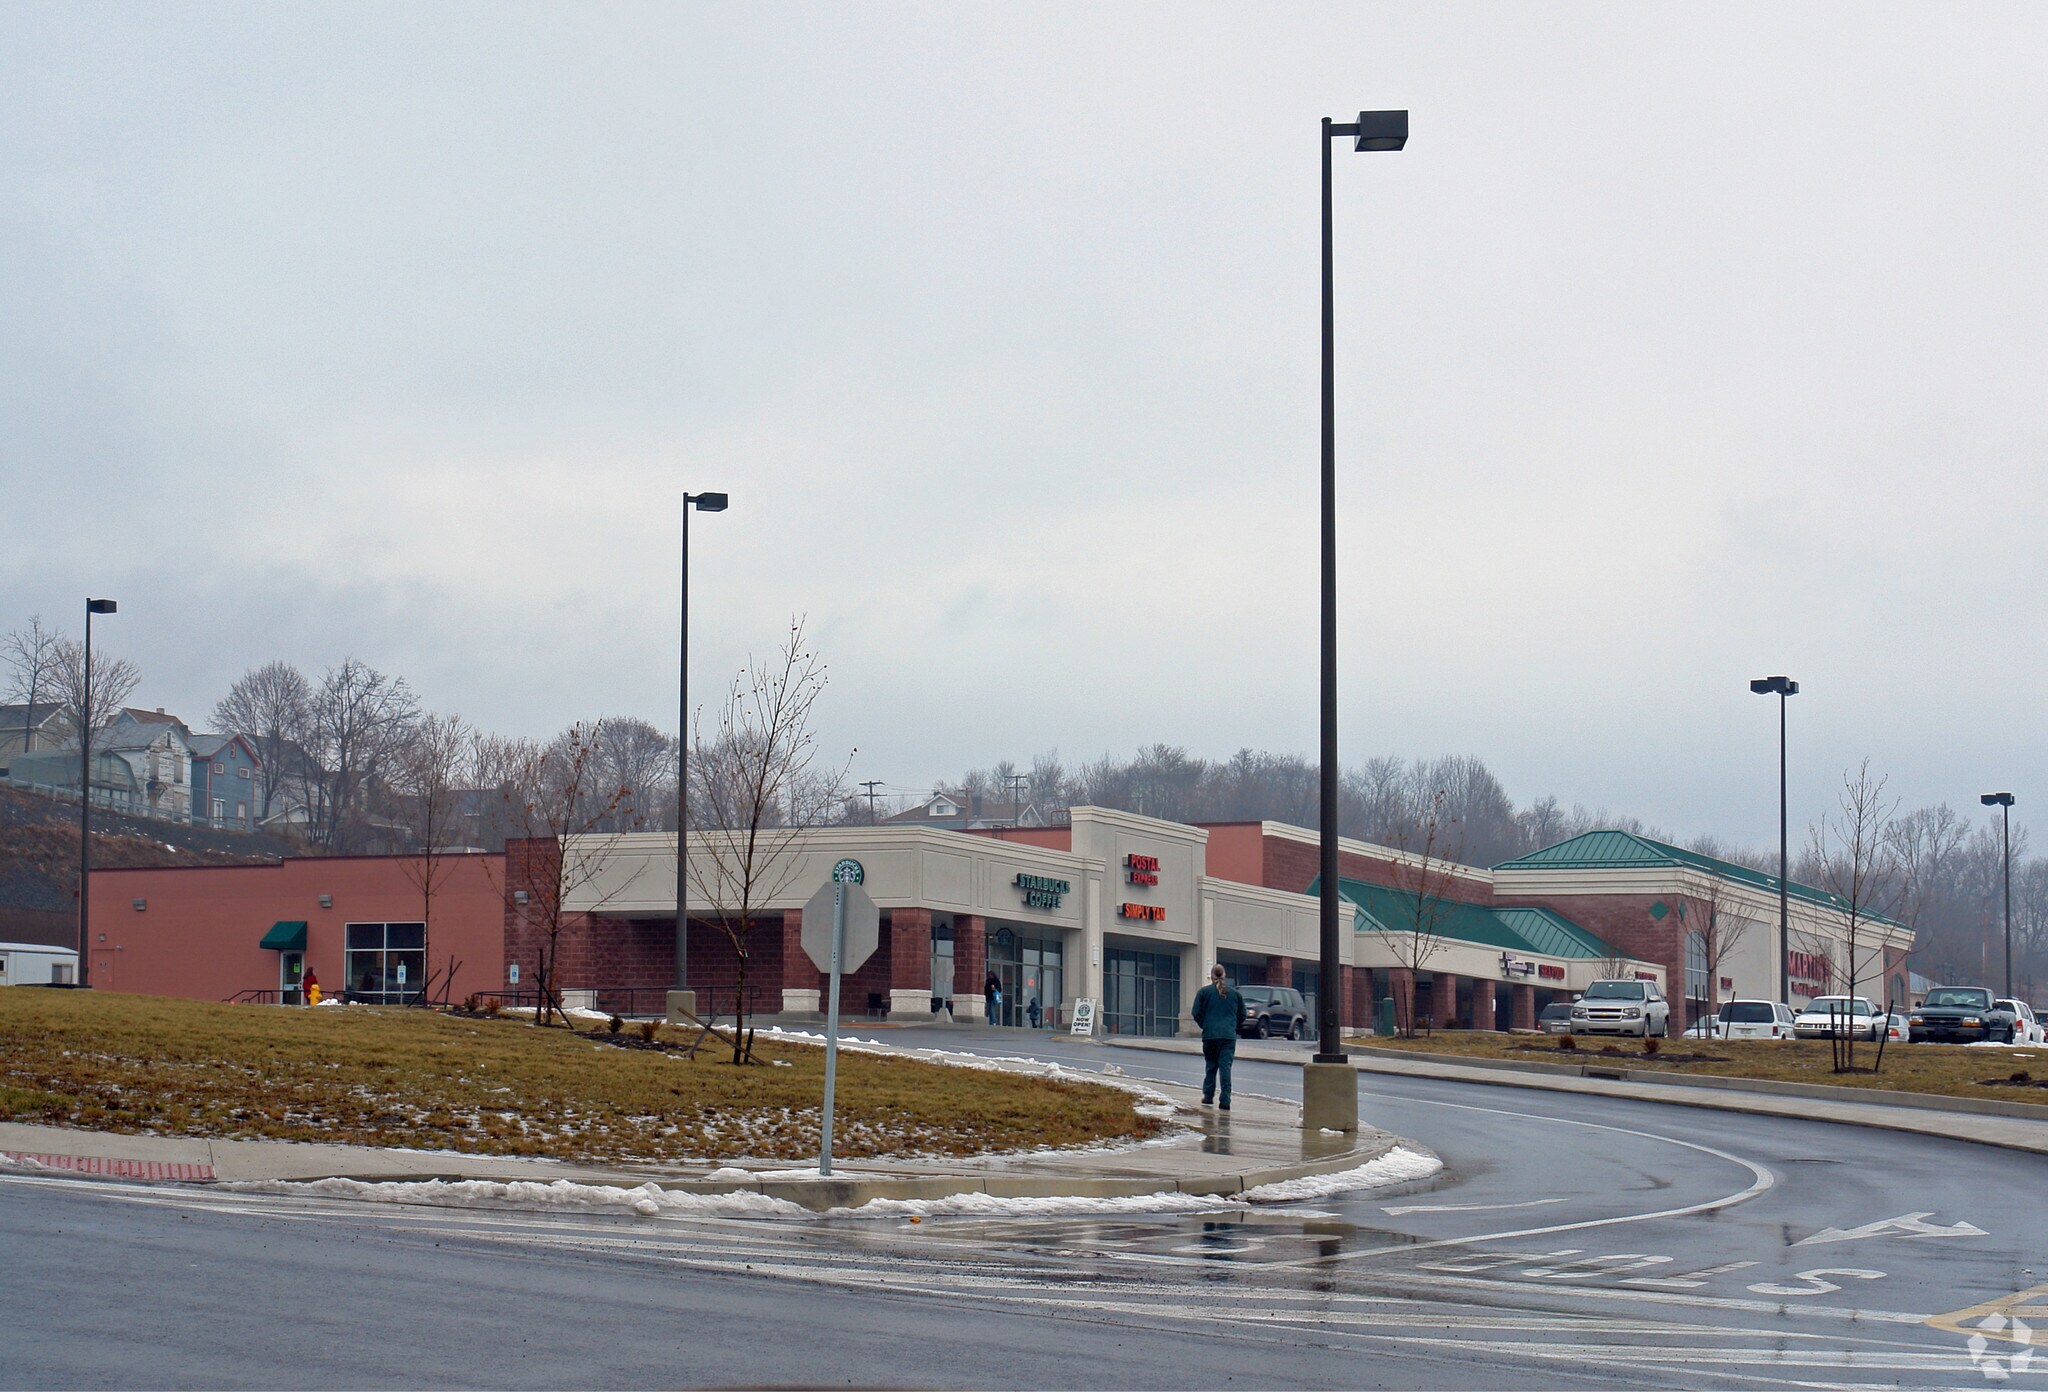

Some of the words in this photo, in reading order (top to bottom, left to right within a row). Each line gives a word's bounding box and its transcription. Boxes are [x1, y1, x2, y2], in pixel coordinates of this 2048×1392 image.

[1129, 854, 1161, 872] POSTAL
[1018, 873, 1070, 895] STARBUCKS
[1132, 872, 1159, 887] EXPRESS
[1028, 891, 1062, 909] COFFEE
[1124, 903, 1150, 920] SIMPLY
[1152, 906, 1166, 922] TAN
